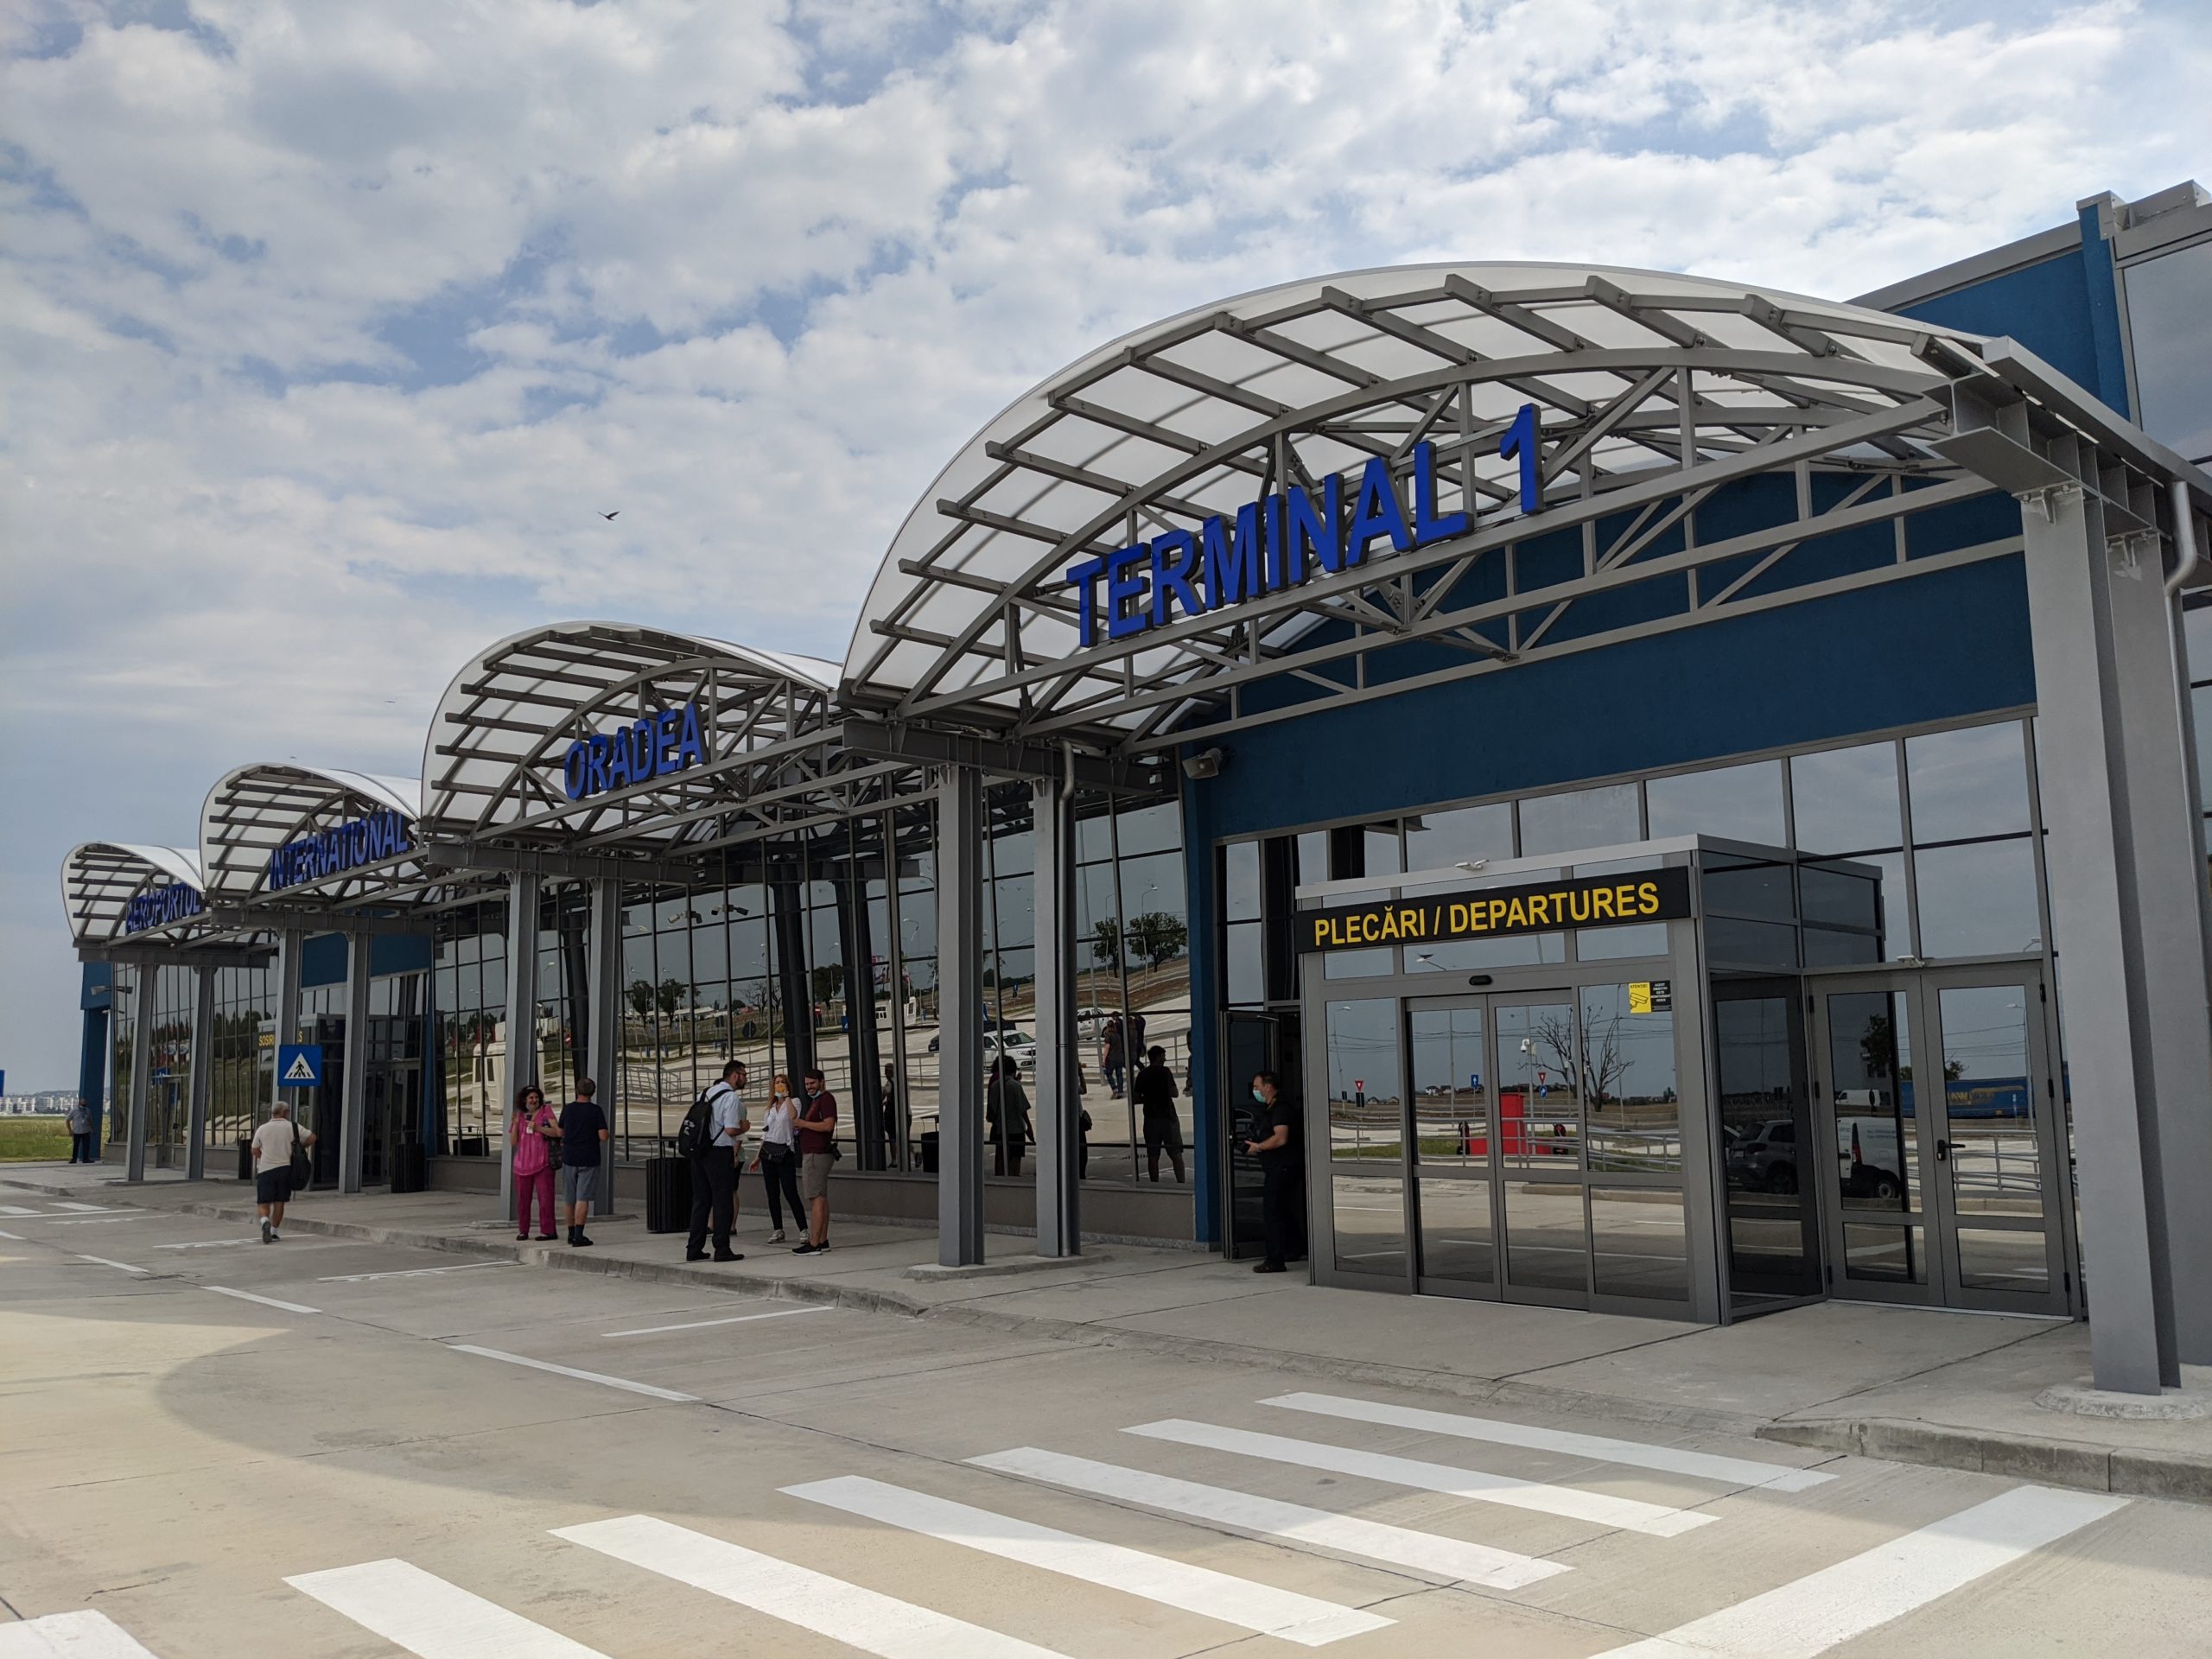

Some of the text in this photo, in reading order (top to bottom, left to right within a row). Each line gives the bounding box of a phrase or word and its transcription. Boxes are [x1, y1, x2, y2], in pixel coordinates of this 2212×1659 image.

[1066, 403, 1541, 647] TERMINAL 1
[564, 702, 707, 800] ORADEA
[270, 808, 408, 891] INTERNATIONAL
[125, 881, 202, 936] AEROPORTUL
[1314, 881, 1660, 947] PLECĂRI / DEPARTURES
[258, 1034, 275, 1046] SOSIR
